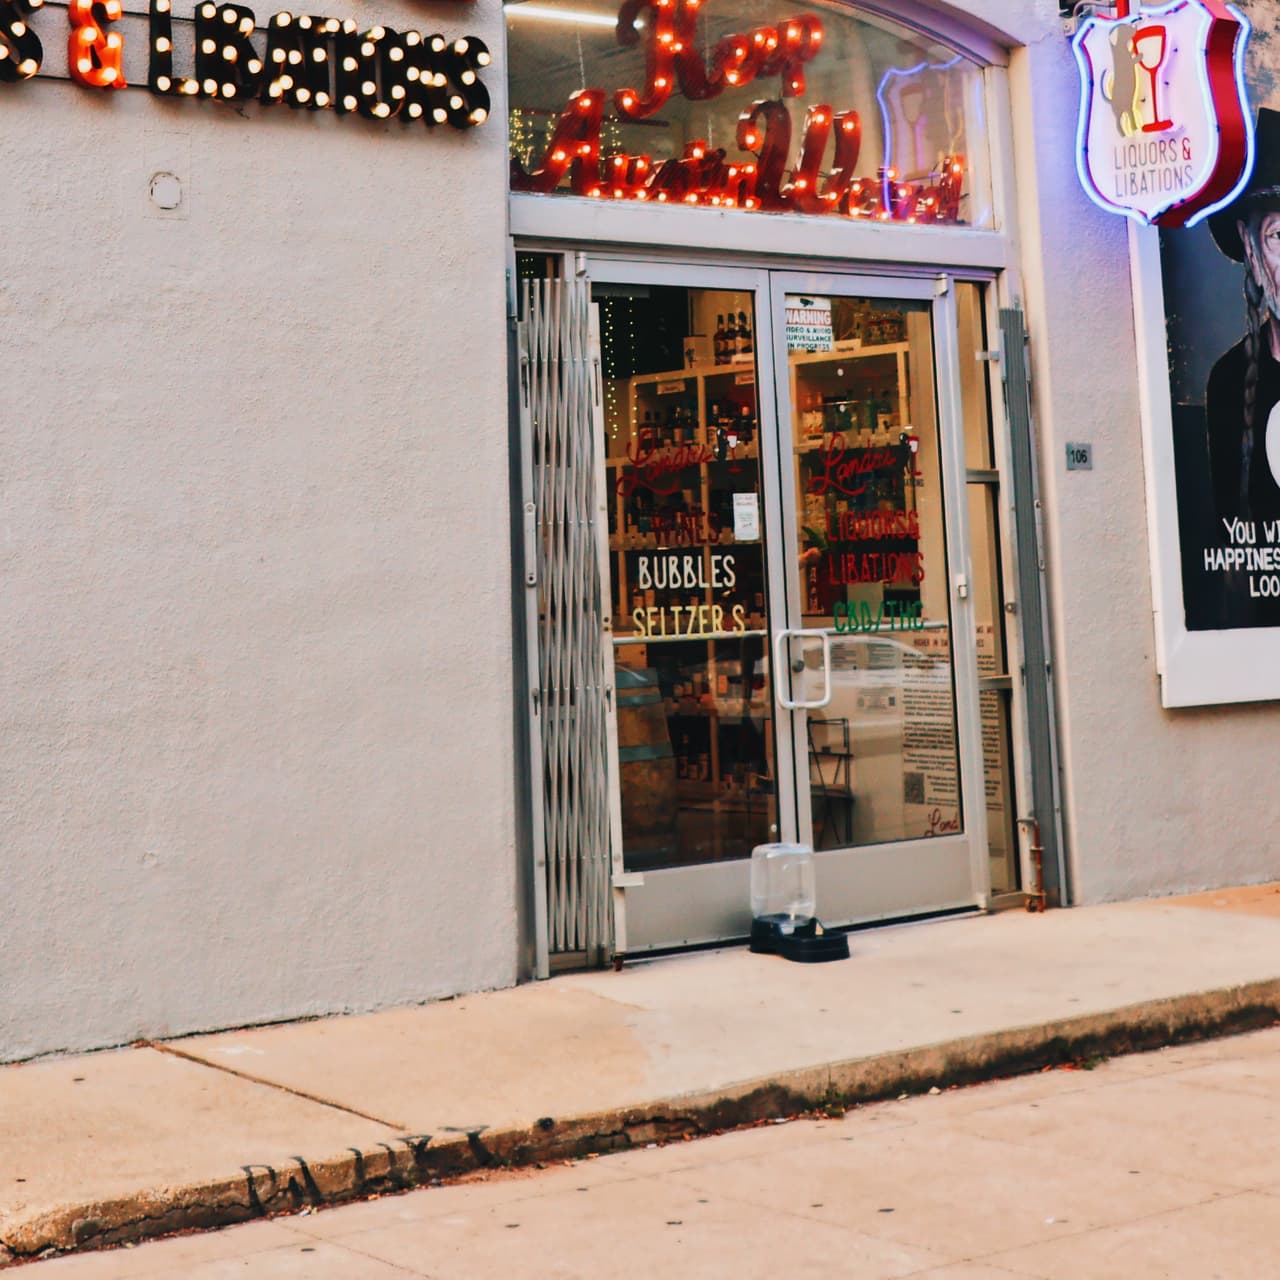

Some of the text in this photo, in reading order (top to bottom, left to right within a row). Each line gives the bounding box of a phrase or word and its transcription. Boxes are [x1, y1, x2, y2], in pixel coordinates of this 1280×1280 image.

[1114, 137, 1191, 170] LIQUORS &
[1115, 164, 1193, 197] LIBATIONS
[785, 309, 831, 325] WARNING
[1070, 449, 1087, 464] 106
[651, 511, 720, 545] WINES
[1222, 516, 1256, 544] YOU
[639, 554, 736, 589] BUBBLES
[827, 551, 925, 587] LIBATIONS
[833, 600, 925, 633] CBD/THC
